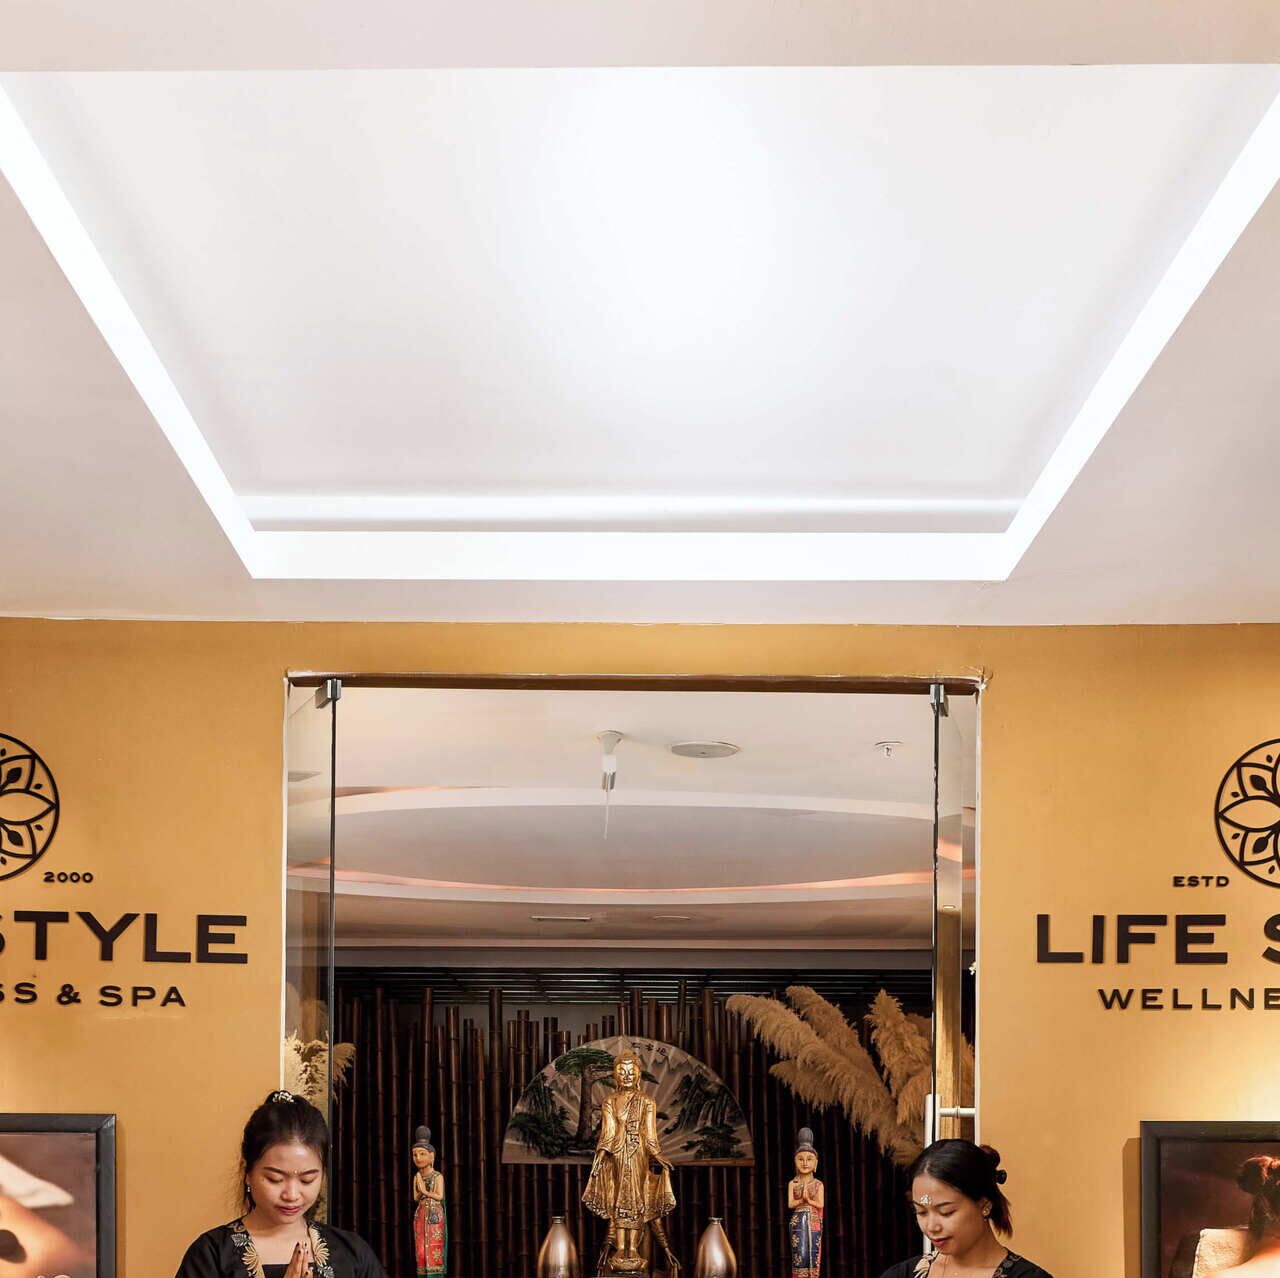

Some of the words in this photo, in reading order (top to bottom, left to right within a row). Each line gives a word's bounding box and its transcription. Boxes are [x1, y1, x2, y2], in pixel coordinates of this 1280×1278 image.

[43, 871, 94, 884] 2000
[1173, 875, 1230, 888] ESTD
[1036, 914, 1228, 965] LIFE
[56, 983, 82, 1006] &
[99, 985, 186, 1007] SPA
